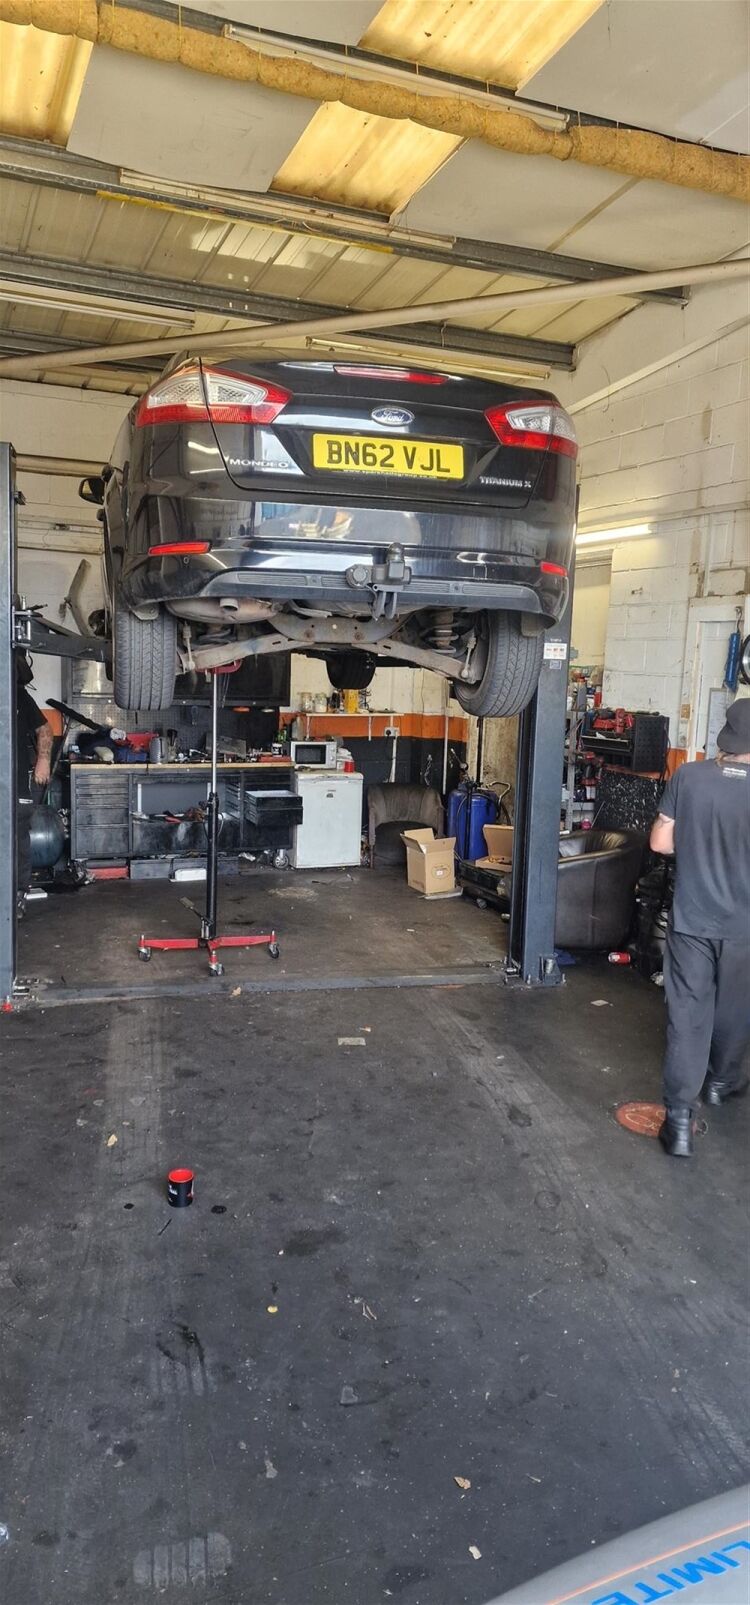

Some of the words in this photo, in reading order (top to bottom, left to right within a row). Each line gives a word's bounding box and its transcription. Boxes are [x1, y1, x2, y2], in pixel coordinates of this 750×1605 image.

[327, 440, 394, 468] BN62
[403, 446, 450, 473] VJL
[229, 458, 289, 469] MONDEO
[479, 476, 523, 487] TITANIUM
[523, 480, 532, 488] X
